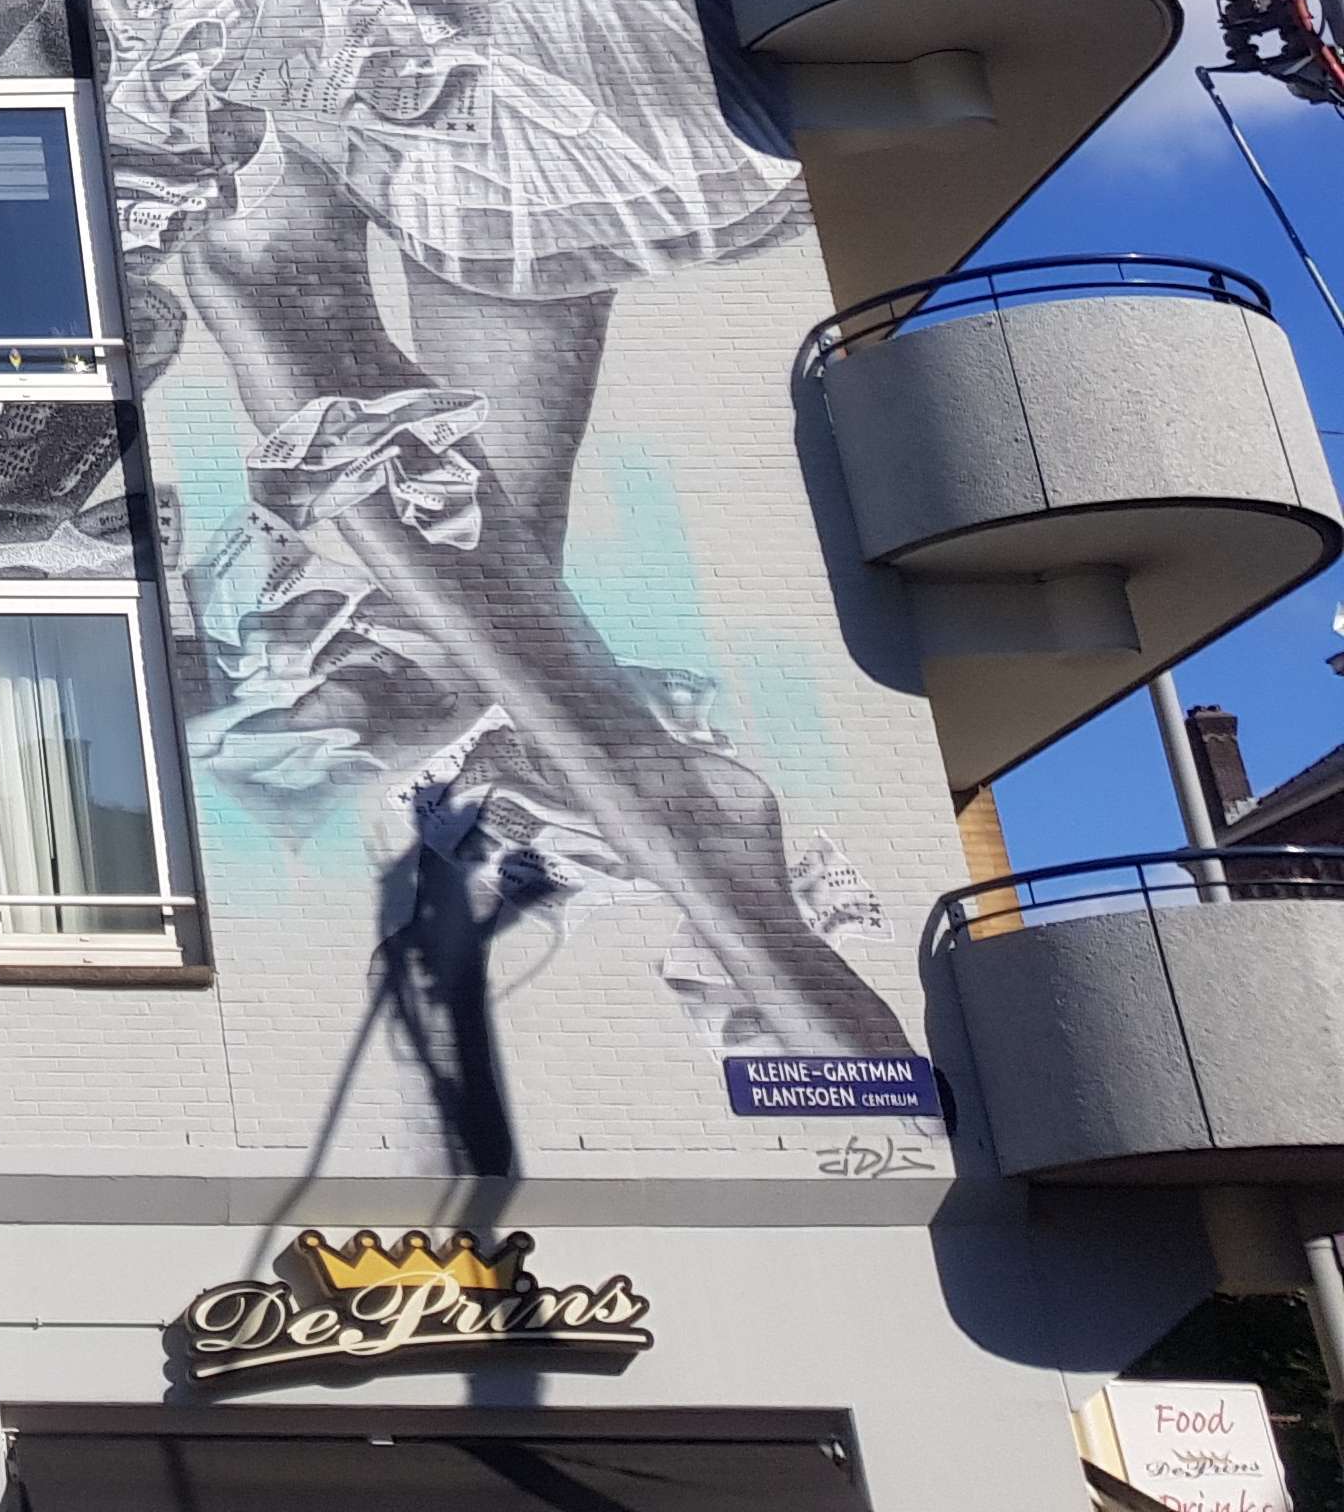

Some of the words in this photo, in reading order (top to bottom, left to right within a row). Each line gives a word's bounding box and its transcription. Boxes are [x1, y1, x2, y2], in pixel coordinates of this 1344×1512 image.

[746, 1061, 913, 1083] KLEINE-GARTMAN
[751, 1086, 856, 1107] PLANTSOEN
[861, 1092, 919, 1107] CENTRUM
[194, 1286, 342, 1352] De
[338, 1271, 642, 1356] Prins
[1154, 1400, 1234, 1434] Food
